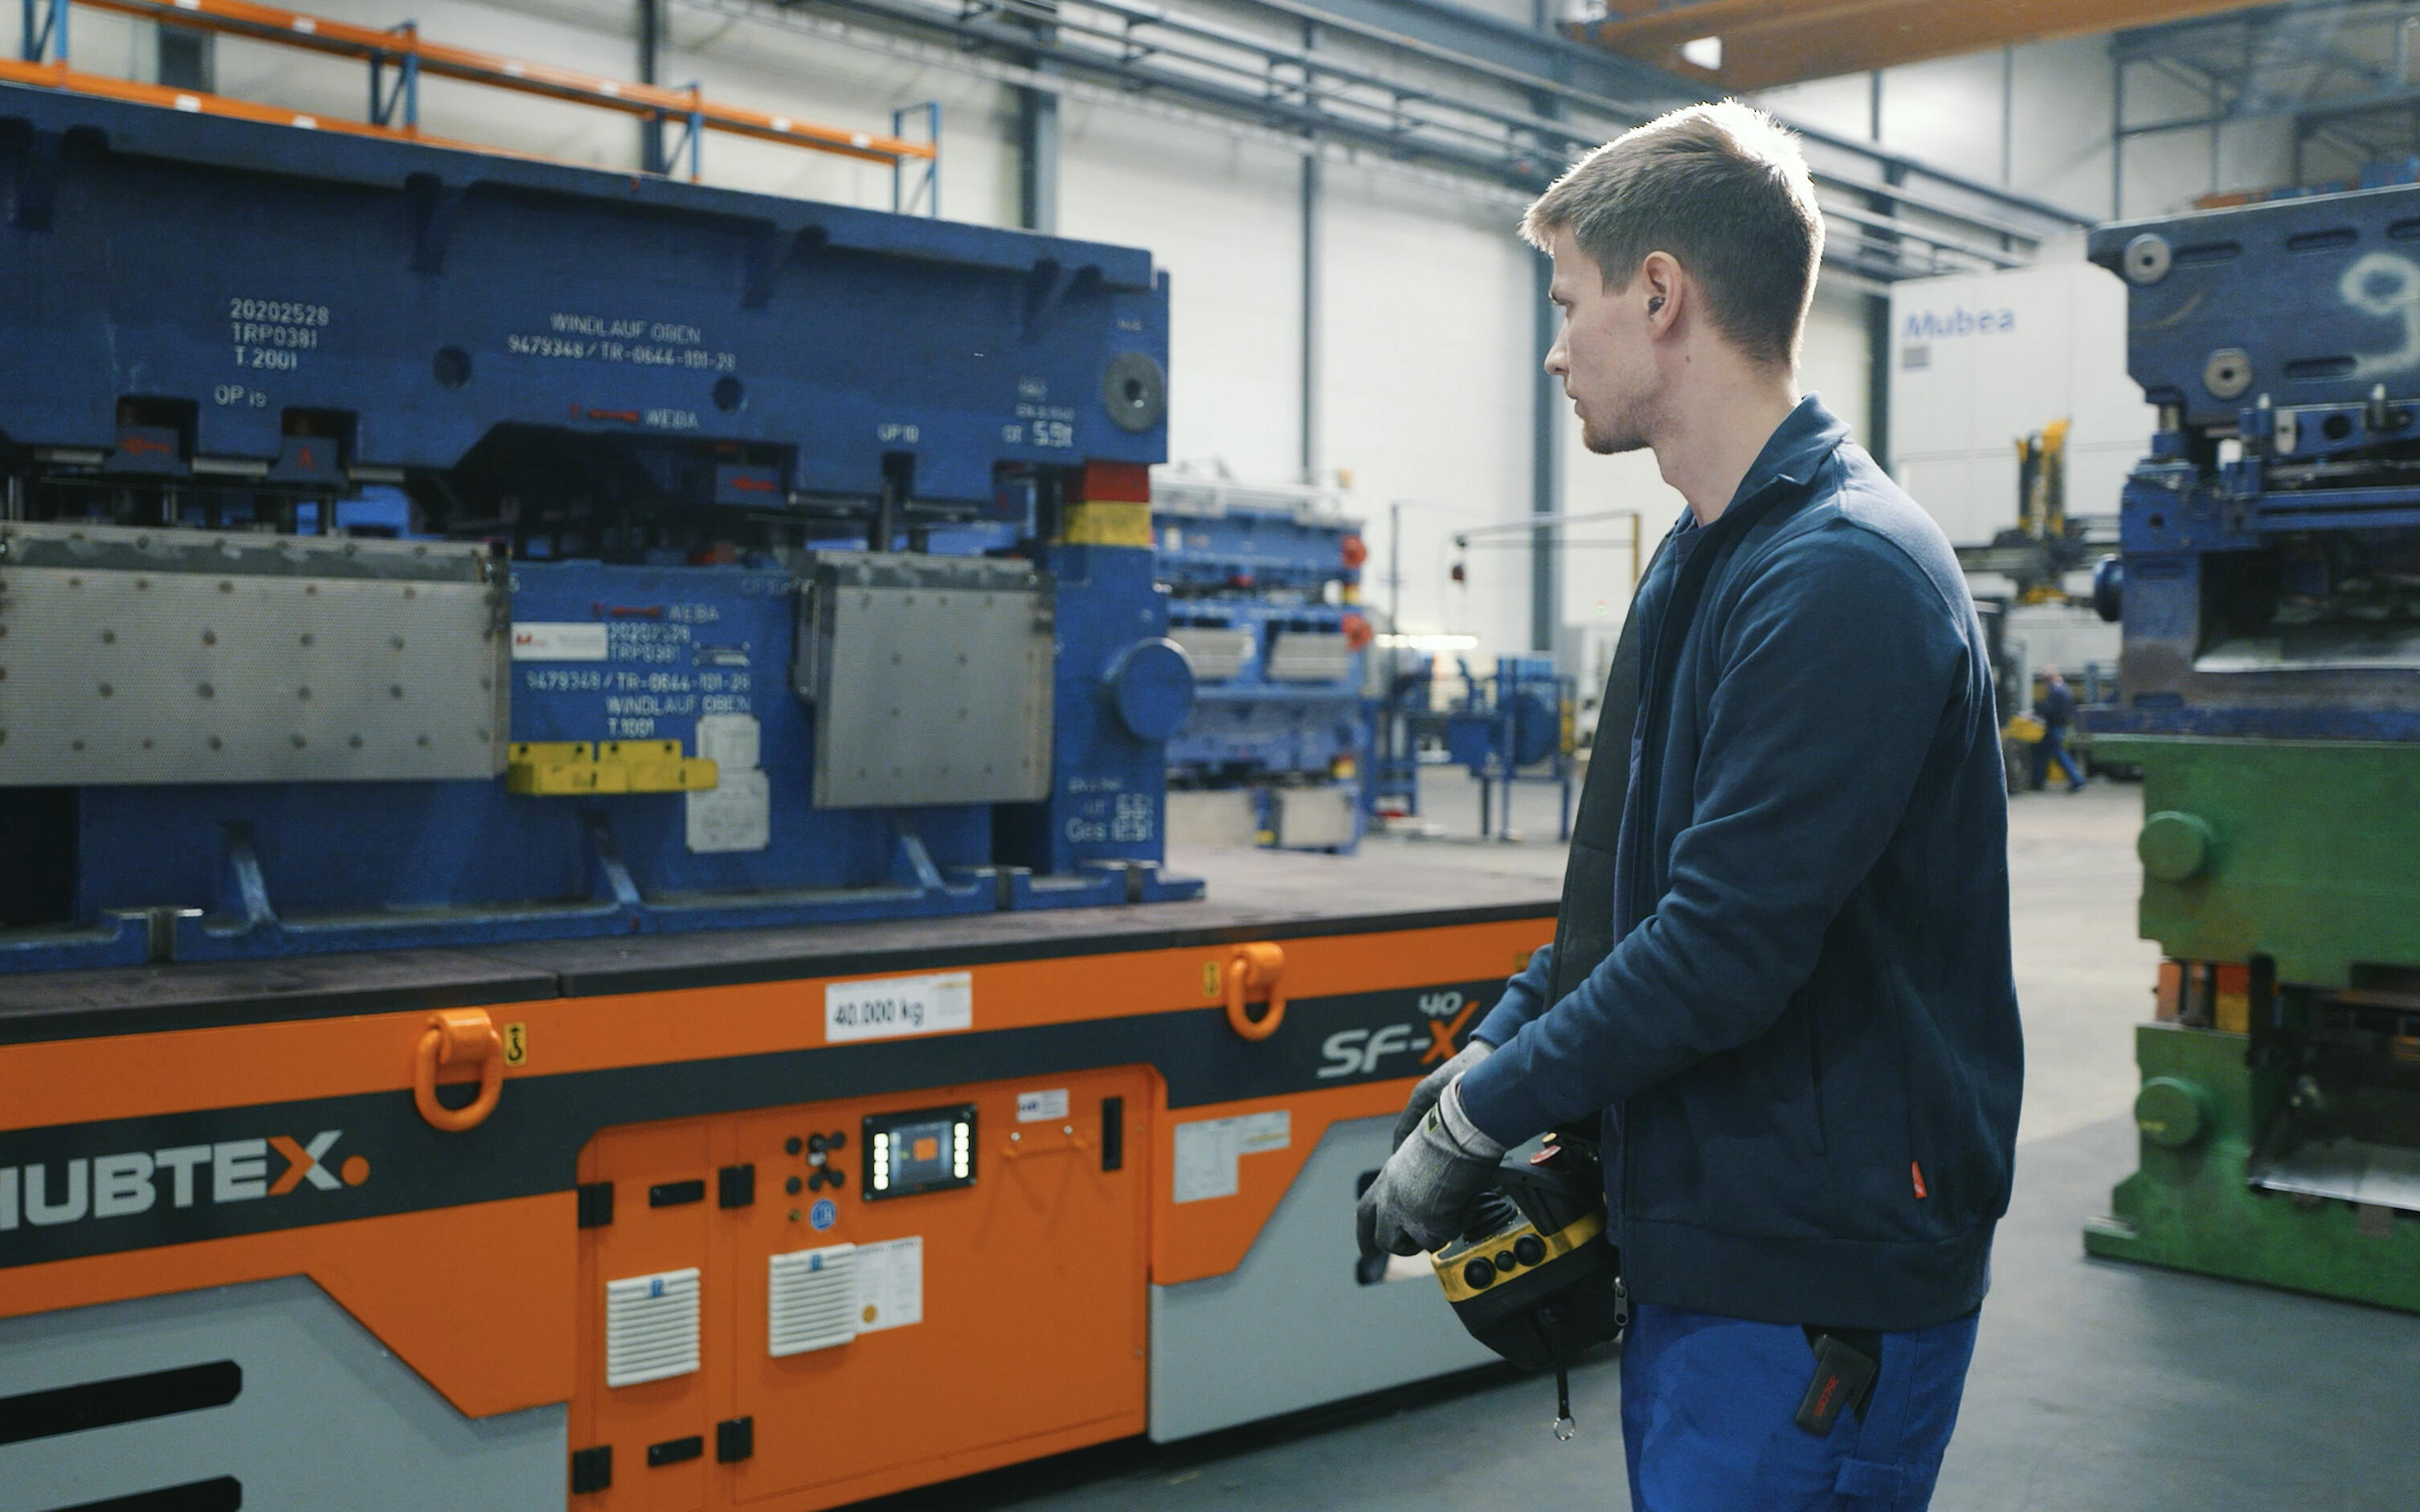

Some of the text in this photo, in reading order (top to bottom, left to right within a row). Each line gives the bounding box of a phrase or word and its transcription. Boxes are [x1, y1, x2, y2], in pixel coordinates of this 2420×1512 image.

[230, 297, 329, 326] 20202528
[1901, 303, 2015, 341] Mubea
[550, 313, 701, 345] WINDLAUF OBEN
[215, 384, 244, 405] OP
[606, 694, 697, 716] WINDLAUF
[834, 995, 924, 1028] 40.000 kg
[1419, 991, 1463, 1016] 40
